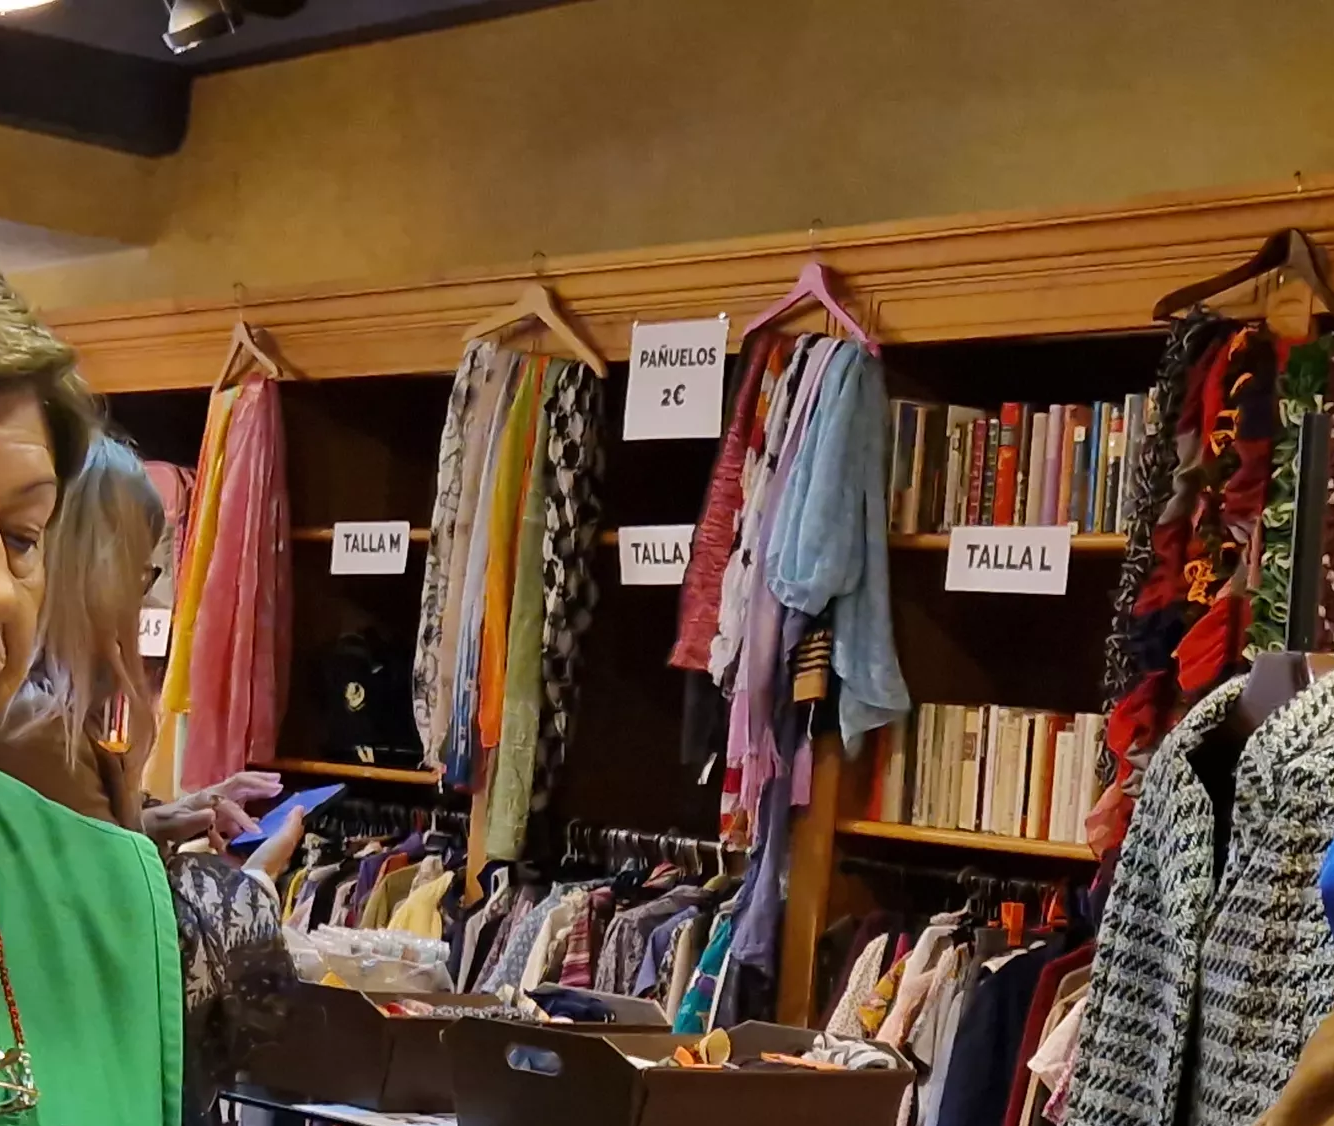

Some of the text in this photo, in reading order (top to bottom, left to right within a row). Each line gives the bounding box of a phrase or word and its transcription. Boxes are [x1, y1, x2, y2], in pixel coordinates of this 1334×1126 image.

[640, 344, 717, 368] PAÑUELOS
[660, 383, 686, 407] 2€
[343, 533, 401, 553] TALLA M
[631, 542, 685, 565] TALLA
[967, 544, 1051, 571] TALLA L
[153, 619, 161, 636] S
